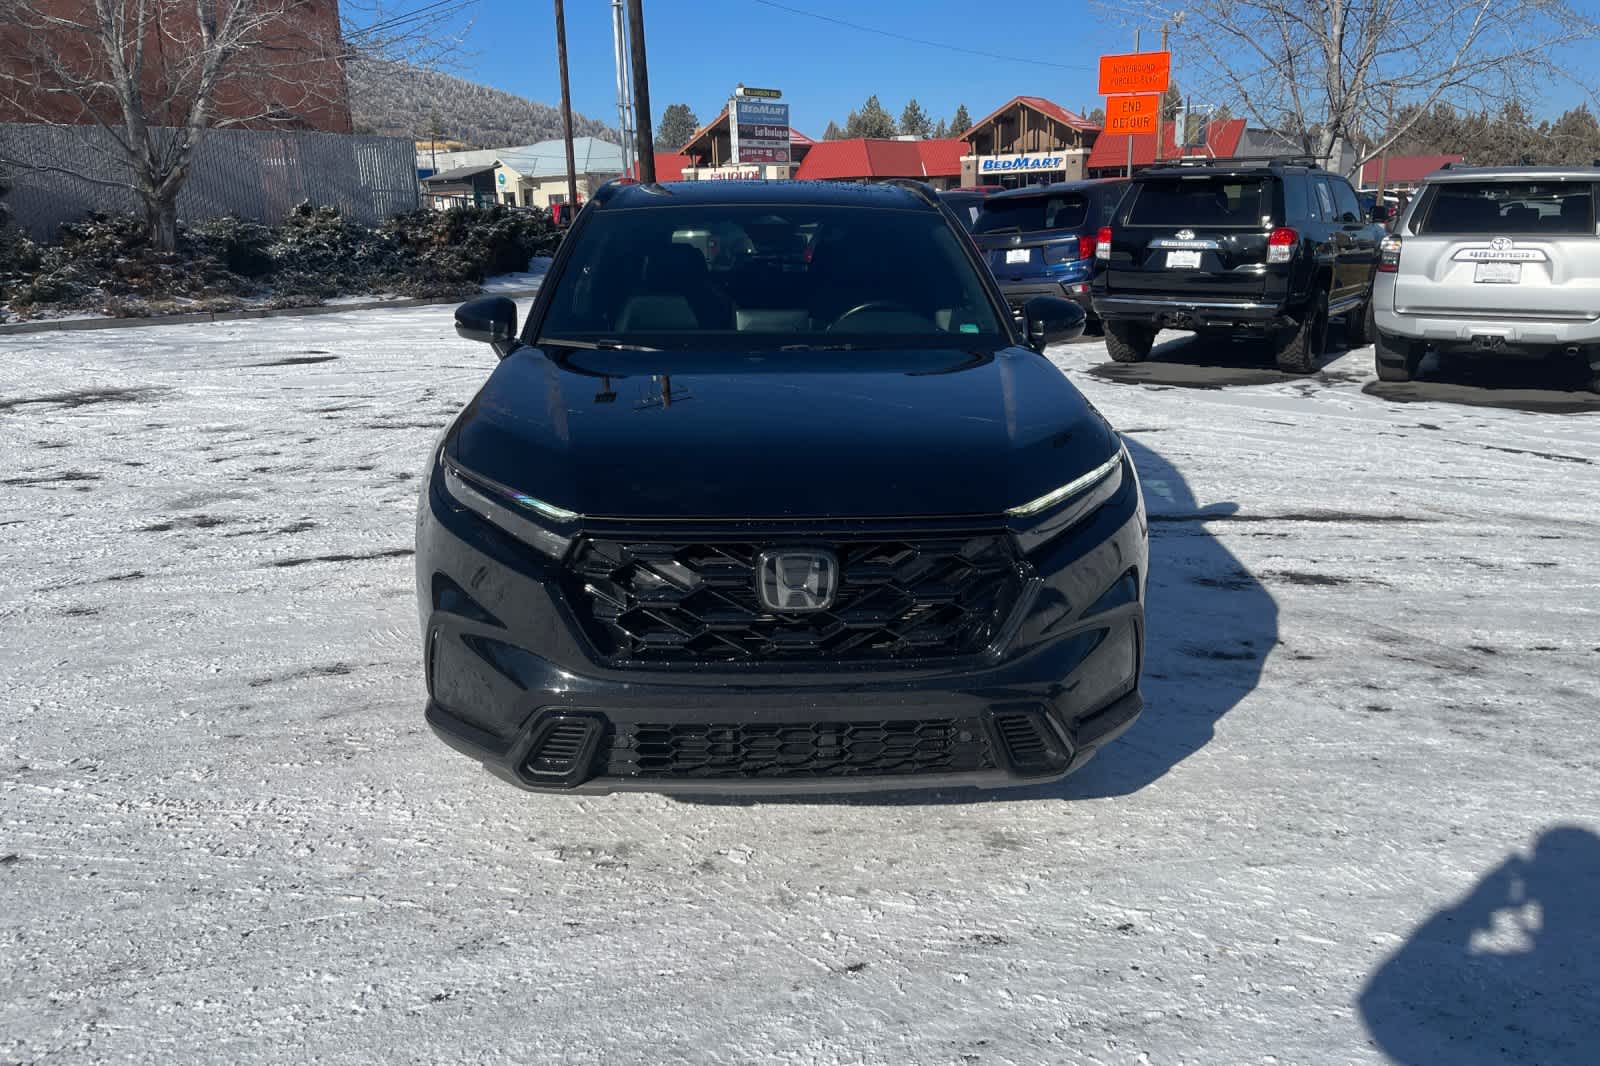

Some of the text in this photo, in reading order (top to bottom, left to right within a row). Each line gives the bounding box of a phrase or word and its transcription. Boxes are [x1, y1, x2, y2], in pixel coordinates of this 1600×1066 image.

[1122, 101, 1142, 113] END
[1112, 116, 1151, 129] DETOUR
[982, 157, 1064, 171] BEDMART
